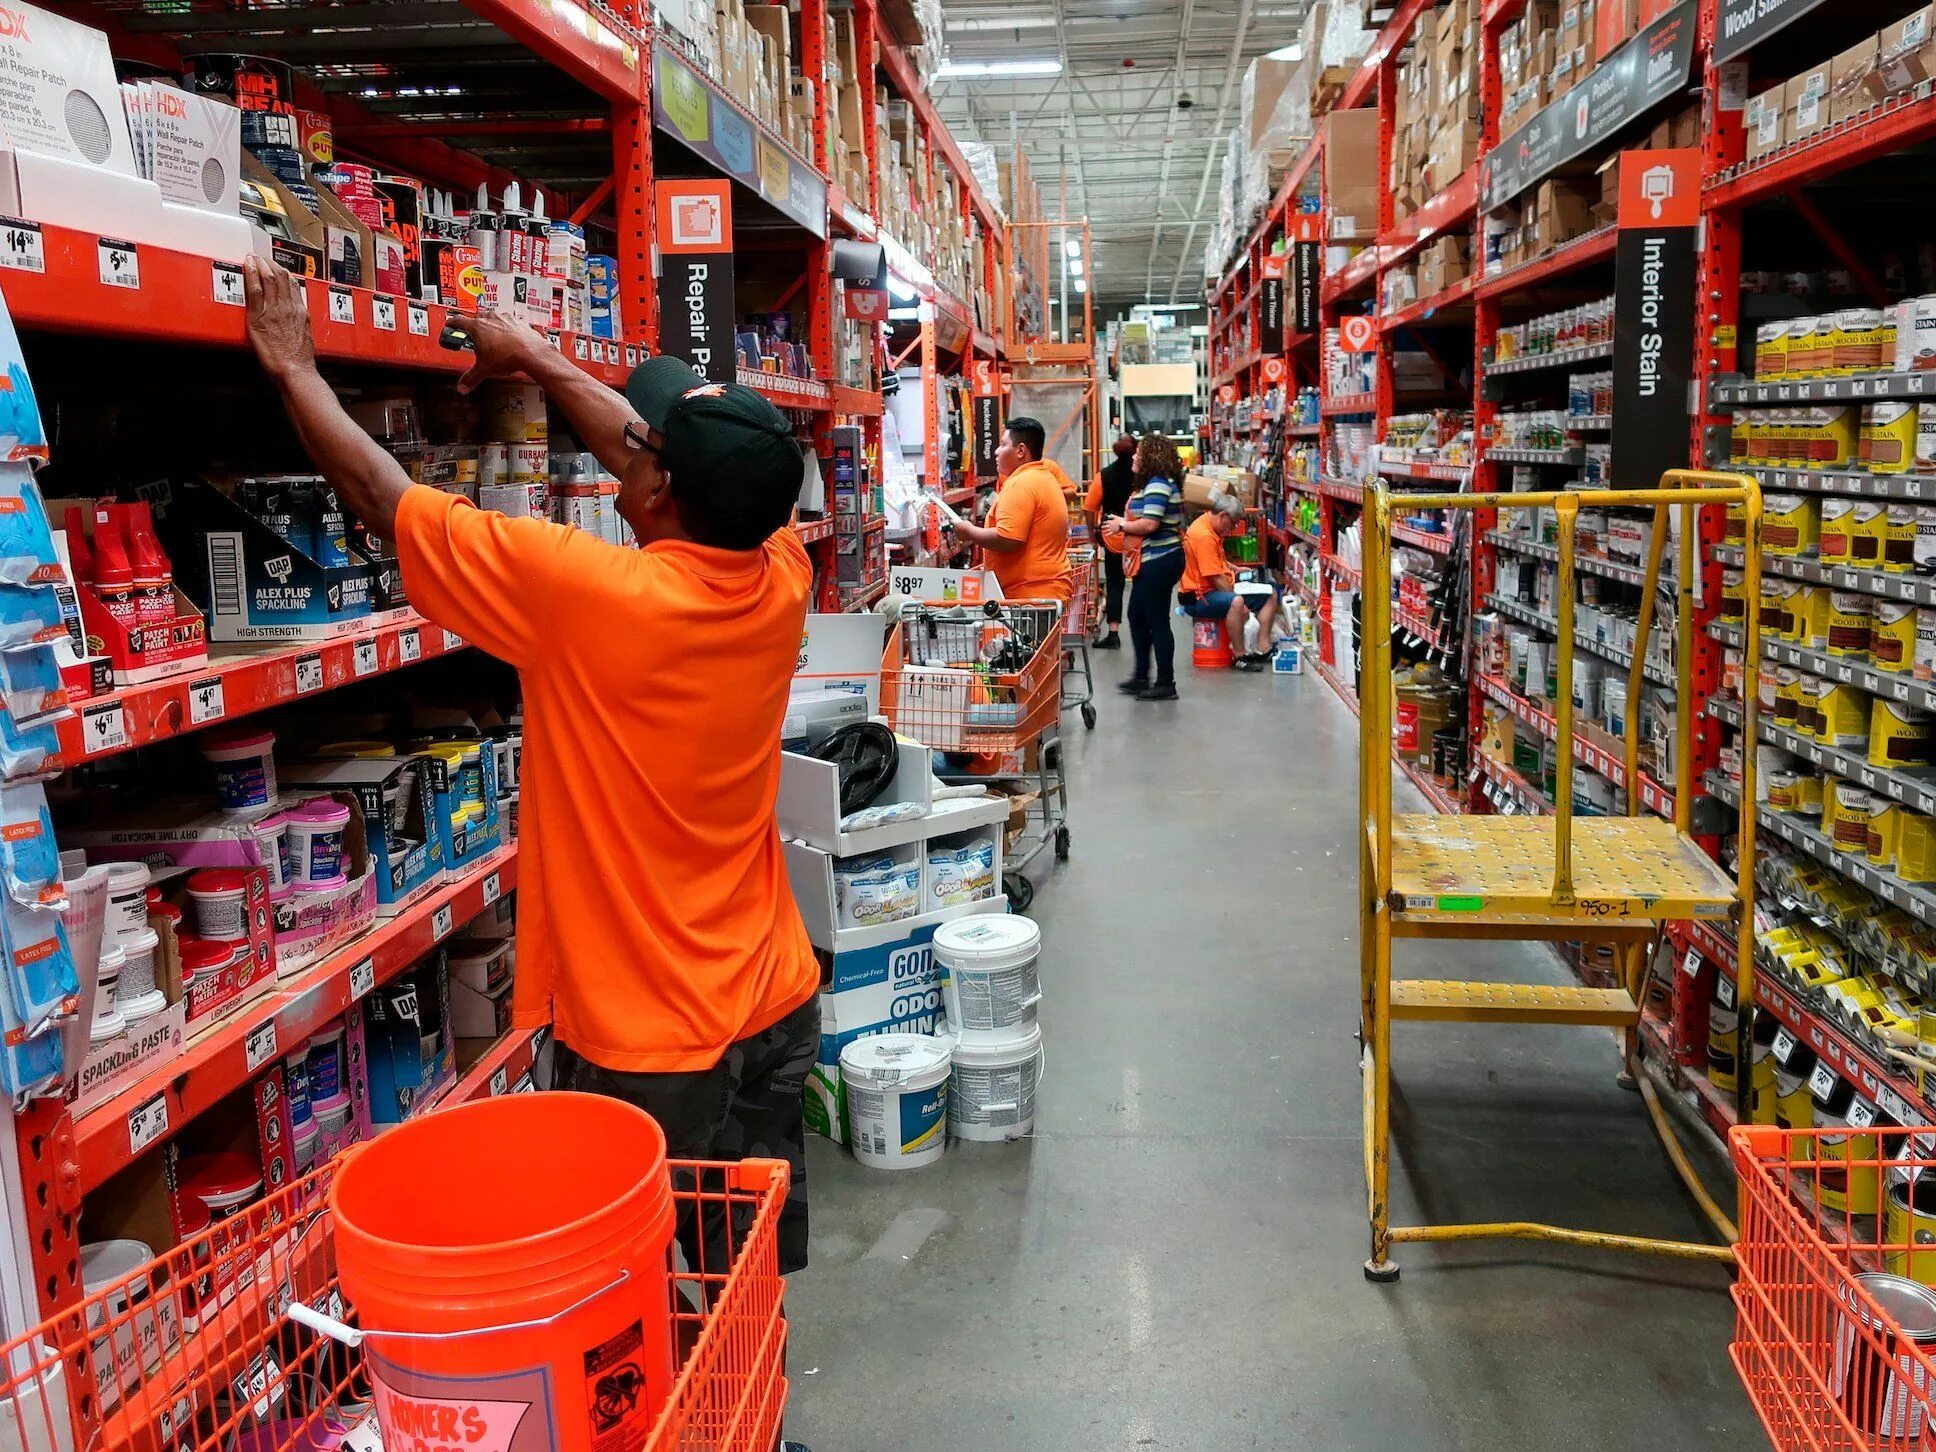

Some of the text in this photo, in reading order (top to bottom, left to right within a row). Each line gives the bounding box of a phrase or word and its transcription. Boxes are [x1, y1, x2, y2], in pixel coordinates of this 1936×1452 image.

[1725, 7, 1755, 39] Wood
[9, 44, 15, 57] 8
[10, 59, 67, 87] Repair Patch
[157, 91, 188, 120] HDX
[157, 128, 169, 140] Wall
[188, 137, 205, 150] Patch
[510, 233, 523, 264] Glazing
[687, 263, 711, 382] Repair Pa
[1639, 237, 1666, 397] Interior Stain
[983, 399, 991, 431] Buckets
[270, 514, 291, 525] PLUS
[267, 557, 291, 575] DAP
[256, 588, 310, 600] ALEX PLUS
[342, 577, 369, 593] ALEX PLUS
[256, 598, 306, 611] SPACKLING
[143, 627, 170, 641] PATCH
[236, 625, 302, 638] HIGH STRENGTH
[144, 641, 169, 651] PAINT
[9, 826, 24, 836] LATEX
[111, 830, 198, 843] DRY TIME INDICATOR
[936, 879, 962, 897] ODOR
[854, 904, 881, 918] ODOR
[1580, 900, 1631, 916] 950-1
[20, 944, 52, 961] LATEX FREE
[192, 975, 220, 995] PATCH
[839, 968, 884, 984] Chemical-Free
[894, 980, 916, 990] natural
[193, 986, 220, 1006] PAINT
[892, 990, 944, 1019] ODO
[210, 995, 244, 1021] LIGHTWEIGHT
[400, 997, 420, 1016] DA
[82, 1024, 171, 1087] SPACKLING PASTE
[144, 1305, 170, 1343] PATE
[386, 1391, 488, 1443] HOMER'S
